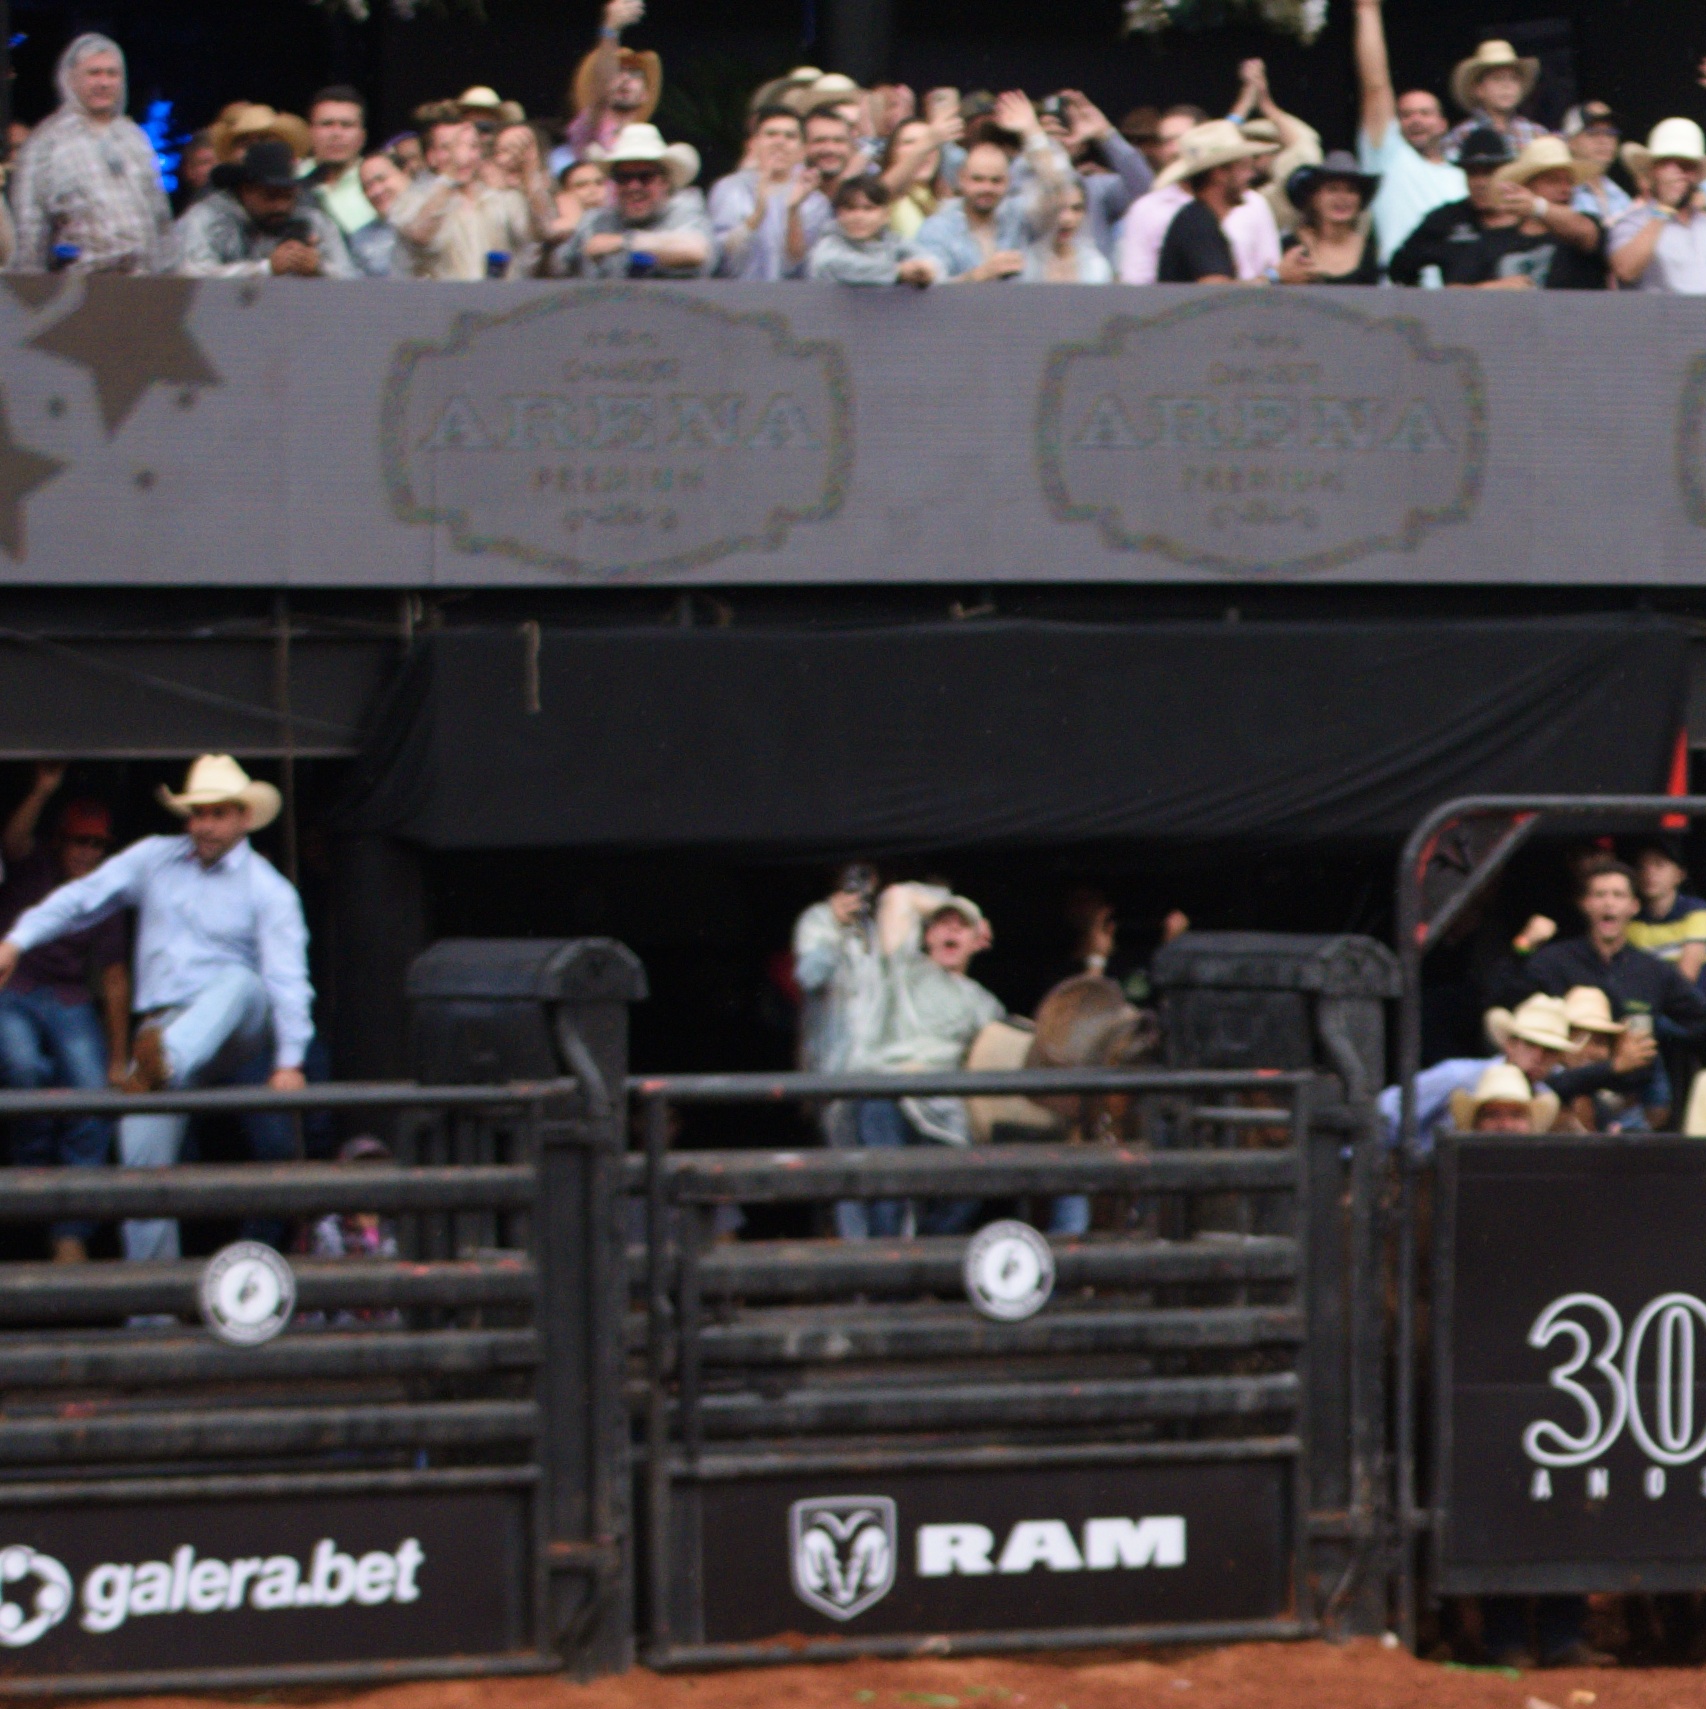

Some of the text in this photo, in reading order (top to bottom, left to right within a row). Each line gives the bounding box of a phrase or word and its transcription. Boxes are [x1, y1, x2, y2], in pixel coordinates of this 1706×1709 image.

[415, 392, 825, 451] ARENA
[1069, 392, 1458, 451] ARENA
[915, 1513, 1187, 1577] RAM
[81, 1537, 426, 1635] galera.bet
